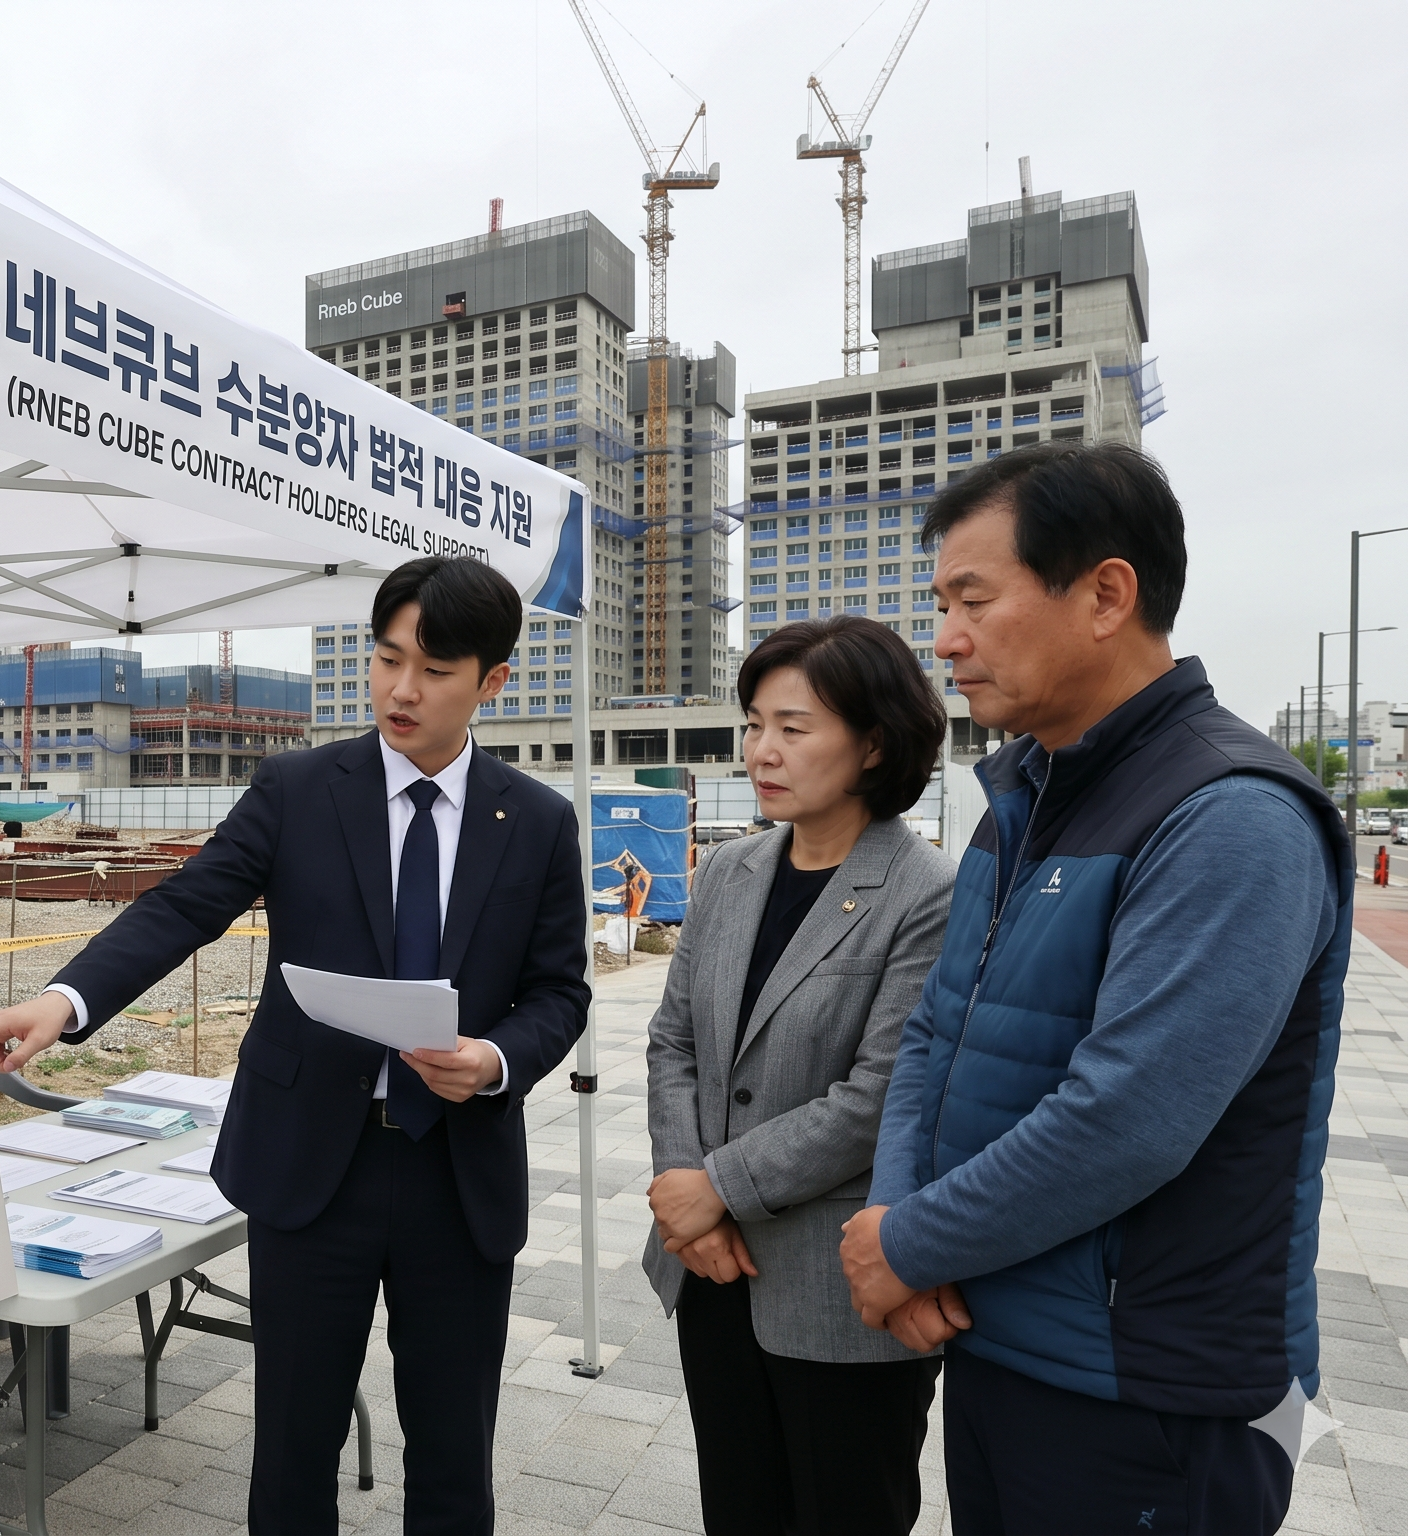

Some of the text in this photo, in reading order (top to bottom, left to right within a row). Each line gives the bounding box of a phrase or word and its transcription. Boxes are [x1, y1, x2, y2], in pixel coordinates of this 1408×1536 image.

[318, 290, 403, 321] Rneb Cube
[7, 375, 91, 438] (RNEB
[98, 412, 165, 465] CUBE
[171, 438, 285, 505] CONTRACT
[287, 481, 368, 534] HOLDERS
[372, 511, 420, 552] LEGAL
[216, 360, 359, 482] 수분양자
[369, 424, 424, 509] 법적
[433, 455, 483, 528] 대응
[489, 480, 532, 549] 지원
